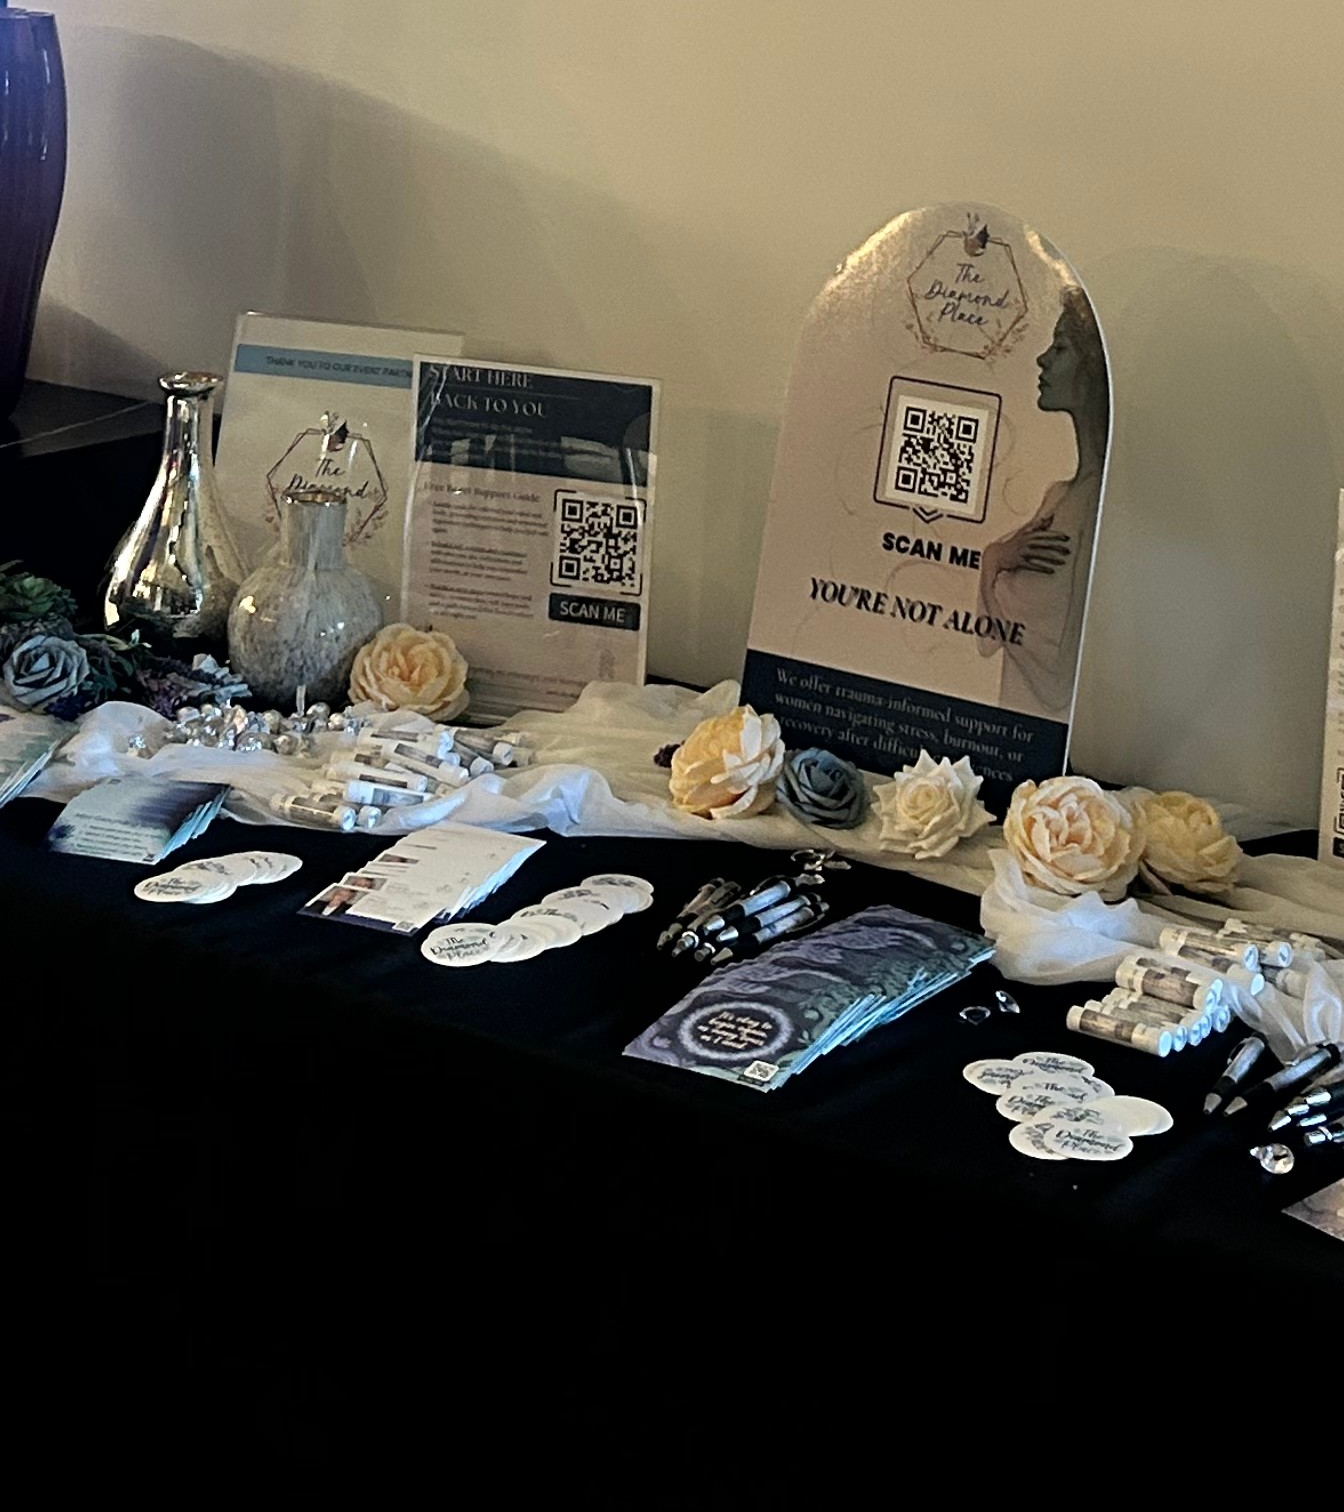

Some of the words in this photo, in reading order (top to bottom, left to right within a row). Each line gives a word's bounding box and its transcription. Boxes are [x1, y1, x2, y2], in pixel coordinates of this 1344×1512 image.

[955, 262, 986, 284] The
[923, 279, 1010, 310] Diamond
[938, 302, 990, 326] Place
[488, 370, 533, 388] HERE
[484, 398, 507, 413] TO
[512, 402, 546, 418] YOU
[882, 532, 943, 562] SCAN
[949, 546, 982, 571] ME
[560, 601, 599, 620] SCAN
[603, 606, 626, 623] ME
[810, 577, 888, 615] YOU'RE
[890, 595, 943, 627] NOT
[943, 609, 1026, 646] ALONE
[775, 692, 822, 714] women
[776, 668, 798, 686] We
[954, 714, 1009, 738] support
[1012, 723, 1034, 743] for
[837, 727, 870, 747] after
